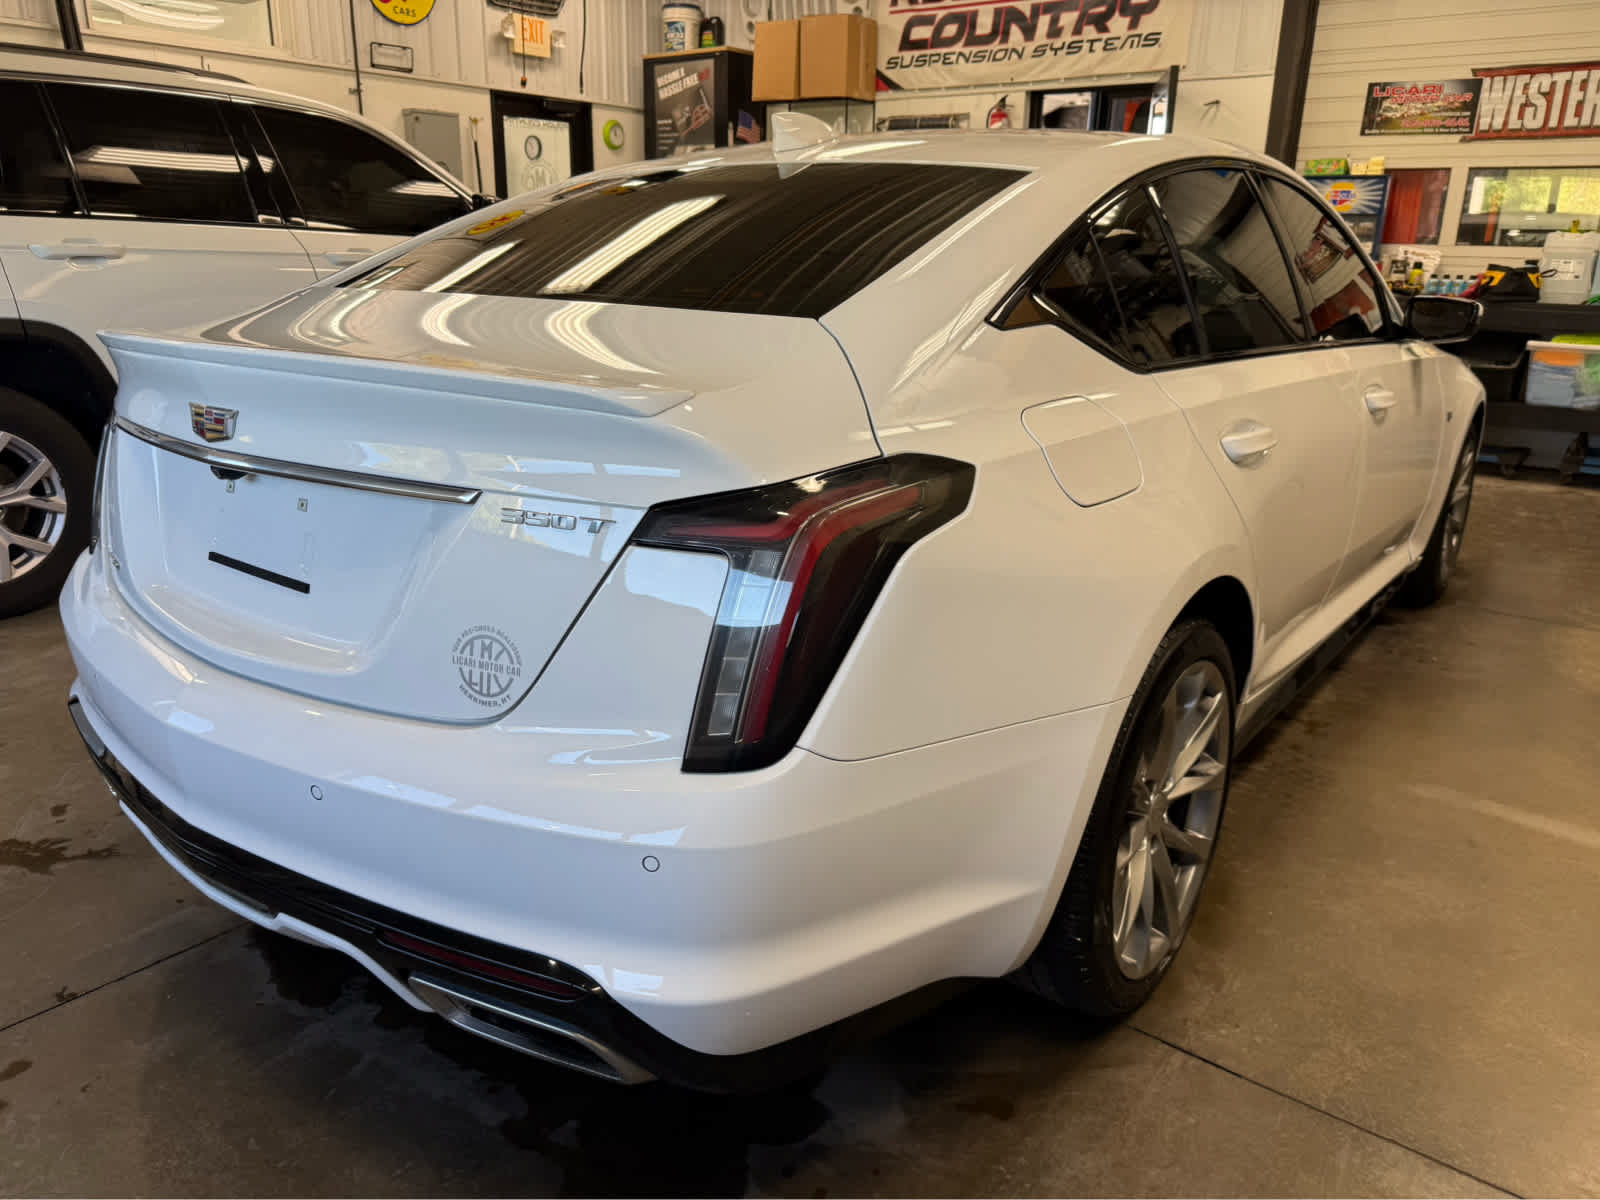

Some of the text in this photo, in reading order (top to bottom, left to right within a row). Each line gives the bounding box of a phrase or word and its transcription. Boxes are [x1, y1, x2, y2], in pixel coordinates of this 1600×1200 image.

[393, 6, 417, 18] CARS
[521, 18, 545, 45] EXIT
[898, 0, 1158, 52] COUNTRY
[885, 31, 1162, 70] SUSPENSION SYSTEMS
[1373, 85, 1443, 97] LICARI
[452, 655, 521, 678] LICARI MOTOR CAR
